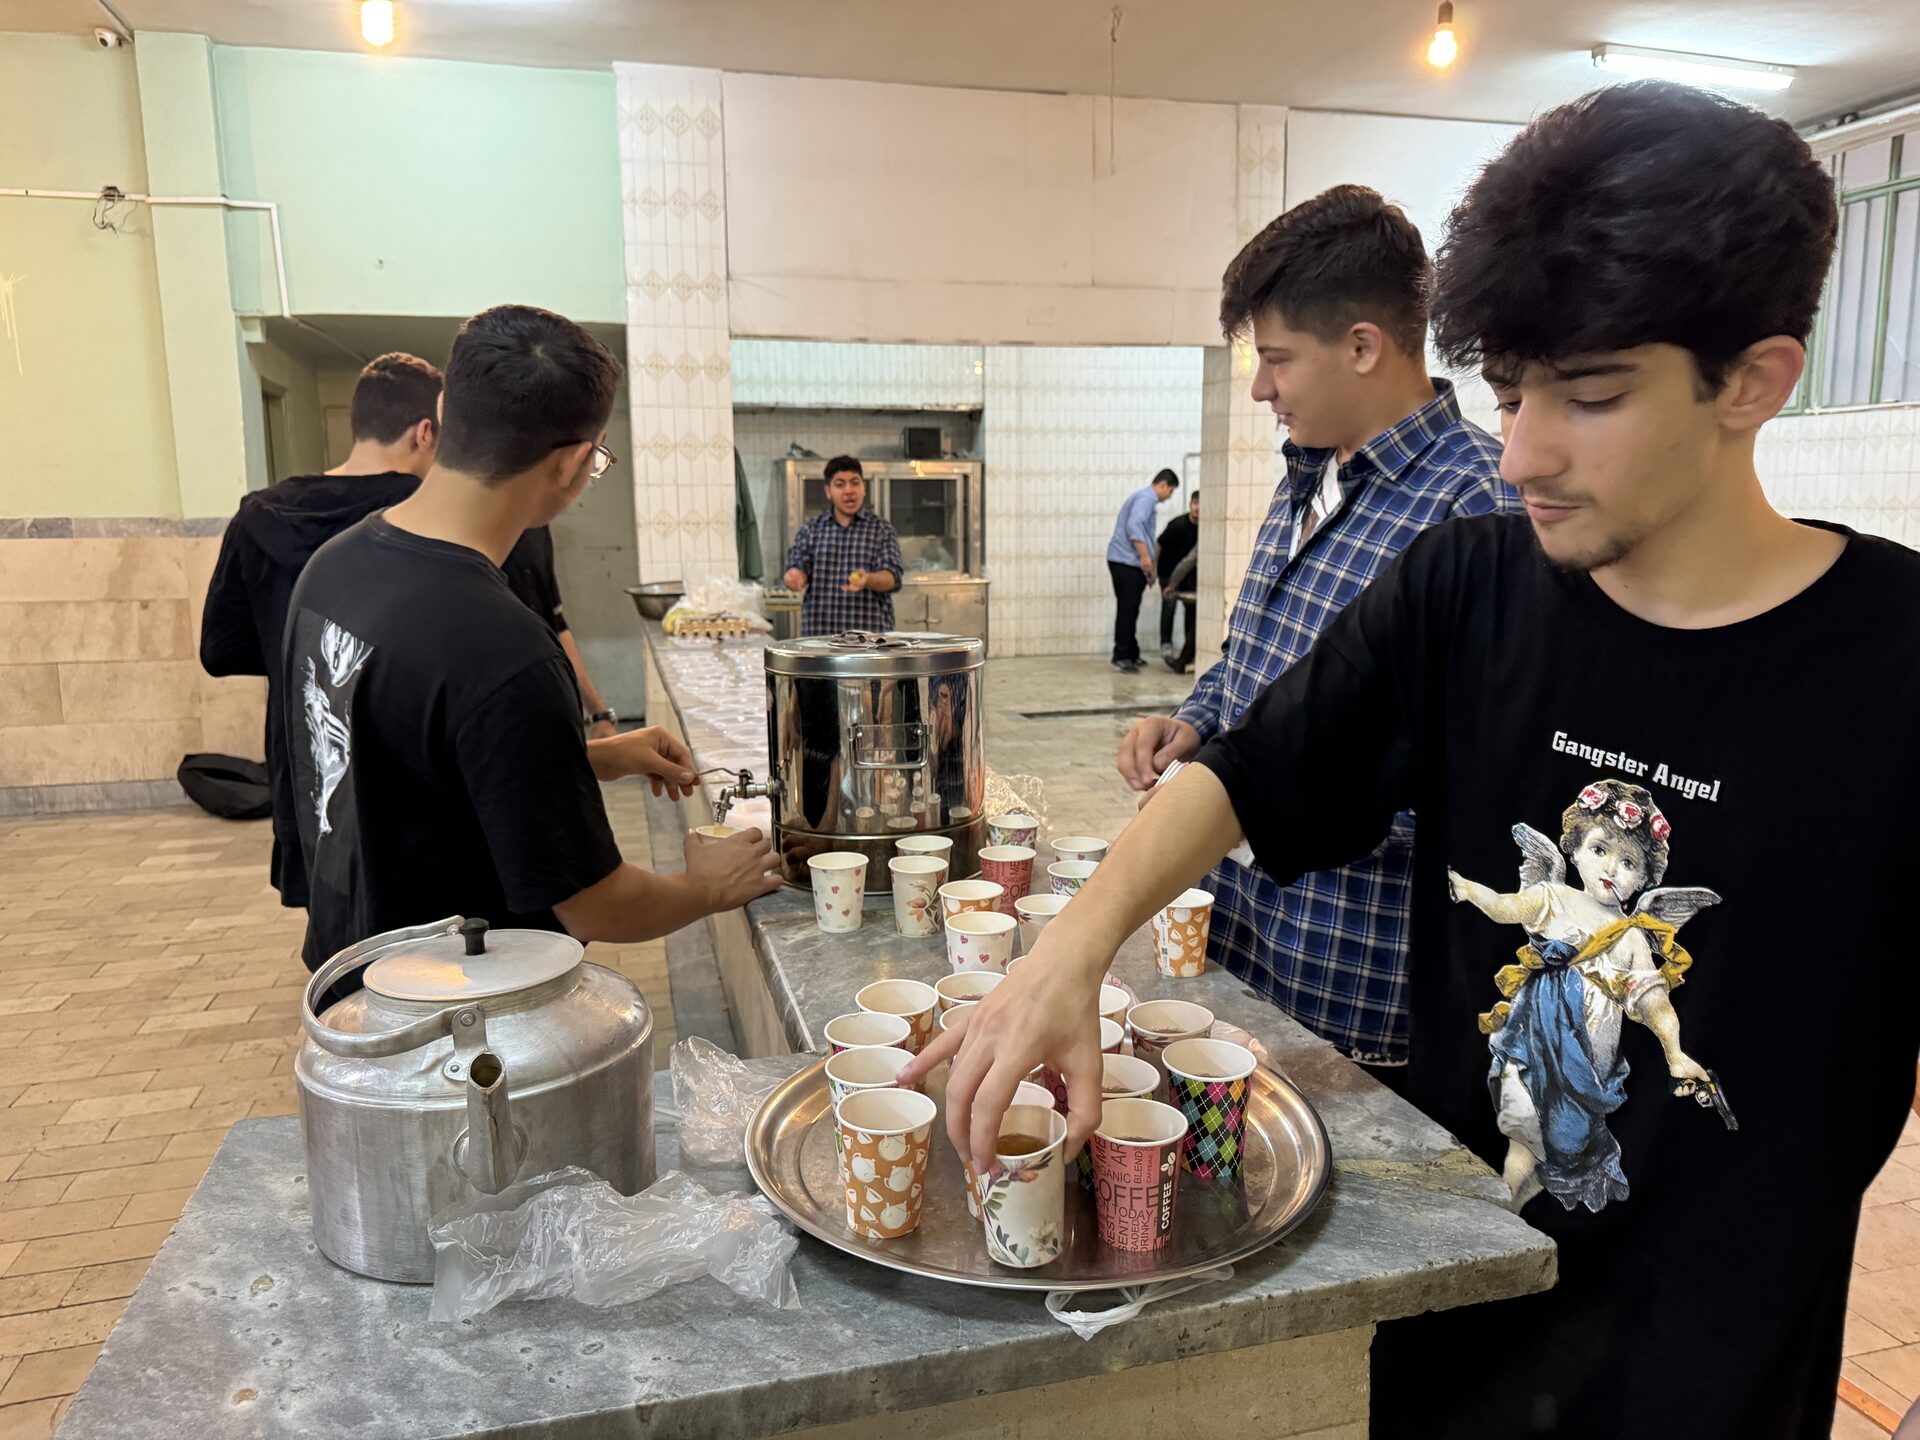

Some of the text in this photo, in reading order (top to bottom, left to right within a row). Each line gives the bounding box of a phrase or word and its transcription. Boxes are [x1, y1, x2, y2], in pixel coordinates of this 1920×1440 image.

[1551, 730, 1721, 802] Gangster Angel
[1133, 1150, 1144, 1185] BLEND
[1160, 1179, 1174, 1230] COFFEE
